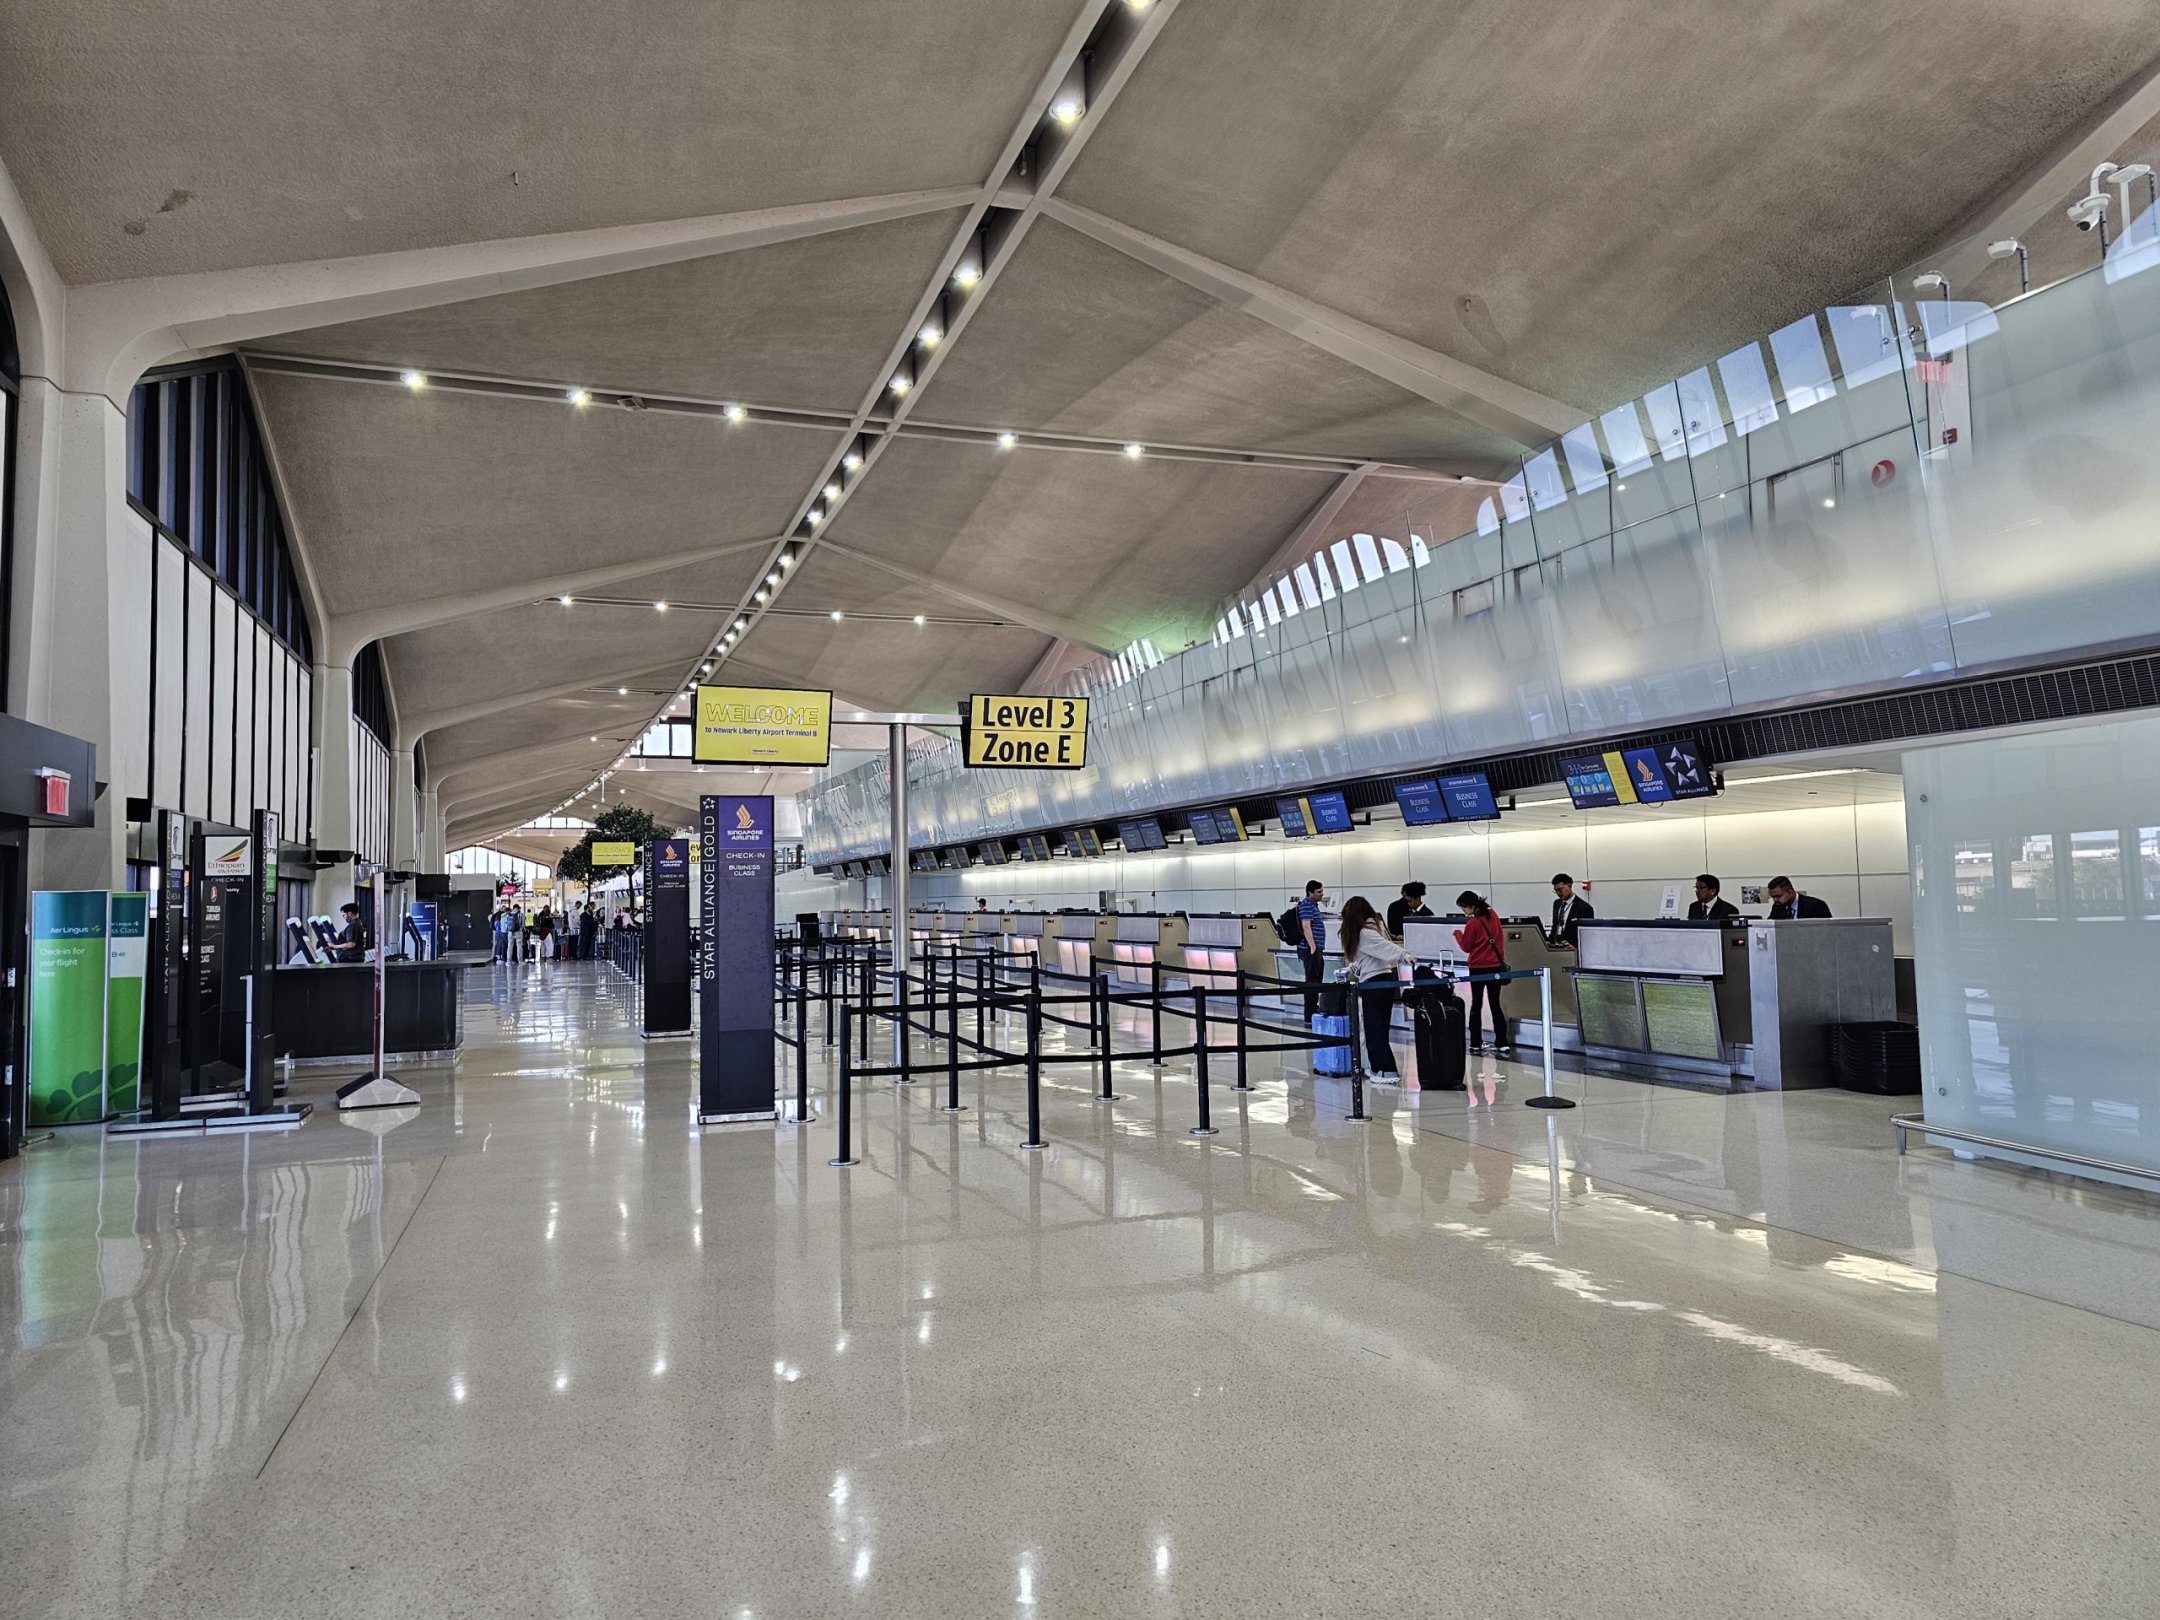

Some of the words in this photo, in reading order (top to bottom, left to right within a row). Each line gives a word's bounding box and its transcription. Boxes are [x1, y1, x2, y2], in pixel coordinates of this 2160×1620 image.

[705, 703, 818, 726] WELCOME
[982, 698, 1053, 728] Level
[1060, 701, 1074, 729] 3
[739, 728, 761, 736] Liberty
[786, 729, 812, 737] Terminal
[982, 733, 1049, 763] Zone
[1057, 735, 1071, 763] E
[1637, 779, 1664, 788] SINGAPORE
[1687, 786, 1710, 794] ALLIANCE
[1456, 792, 1478, 801] BUSINESS
[1409, 798, 1430, 806] BUSINESS
[1461, 800, 1477, 808] CLASS
[704, 816, 715, 857] GOLD
[645, 851, 653, 896] ALLIANCE
[704, 864, 715, 936] ALLIANCE
[645, 899, 653, 923] STAR
[63, 926, 89, 934] Lingus
[40, 948, 71, 956] Check-in
[40, 960, 56, 968] your
[56, 959, 78, 967] flight
[704, 942, 715, 980] STAR
